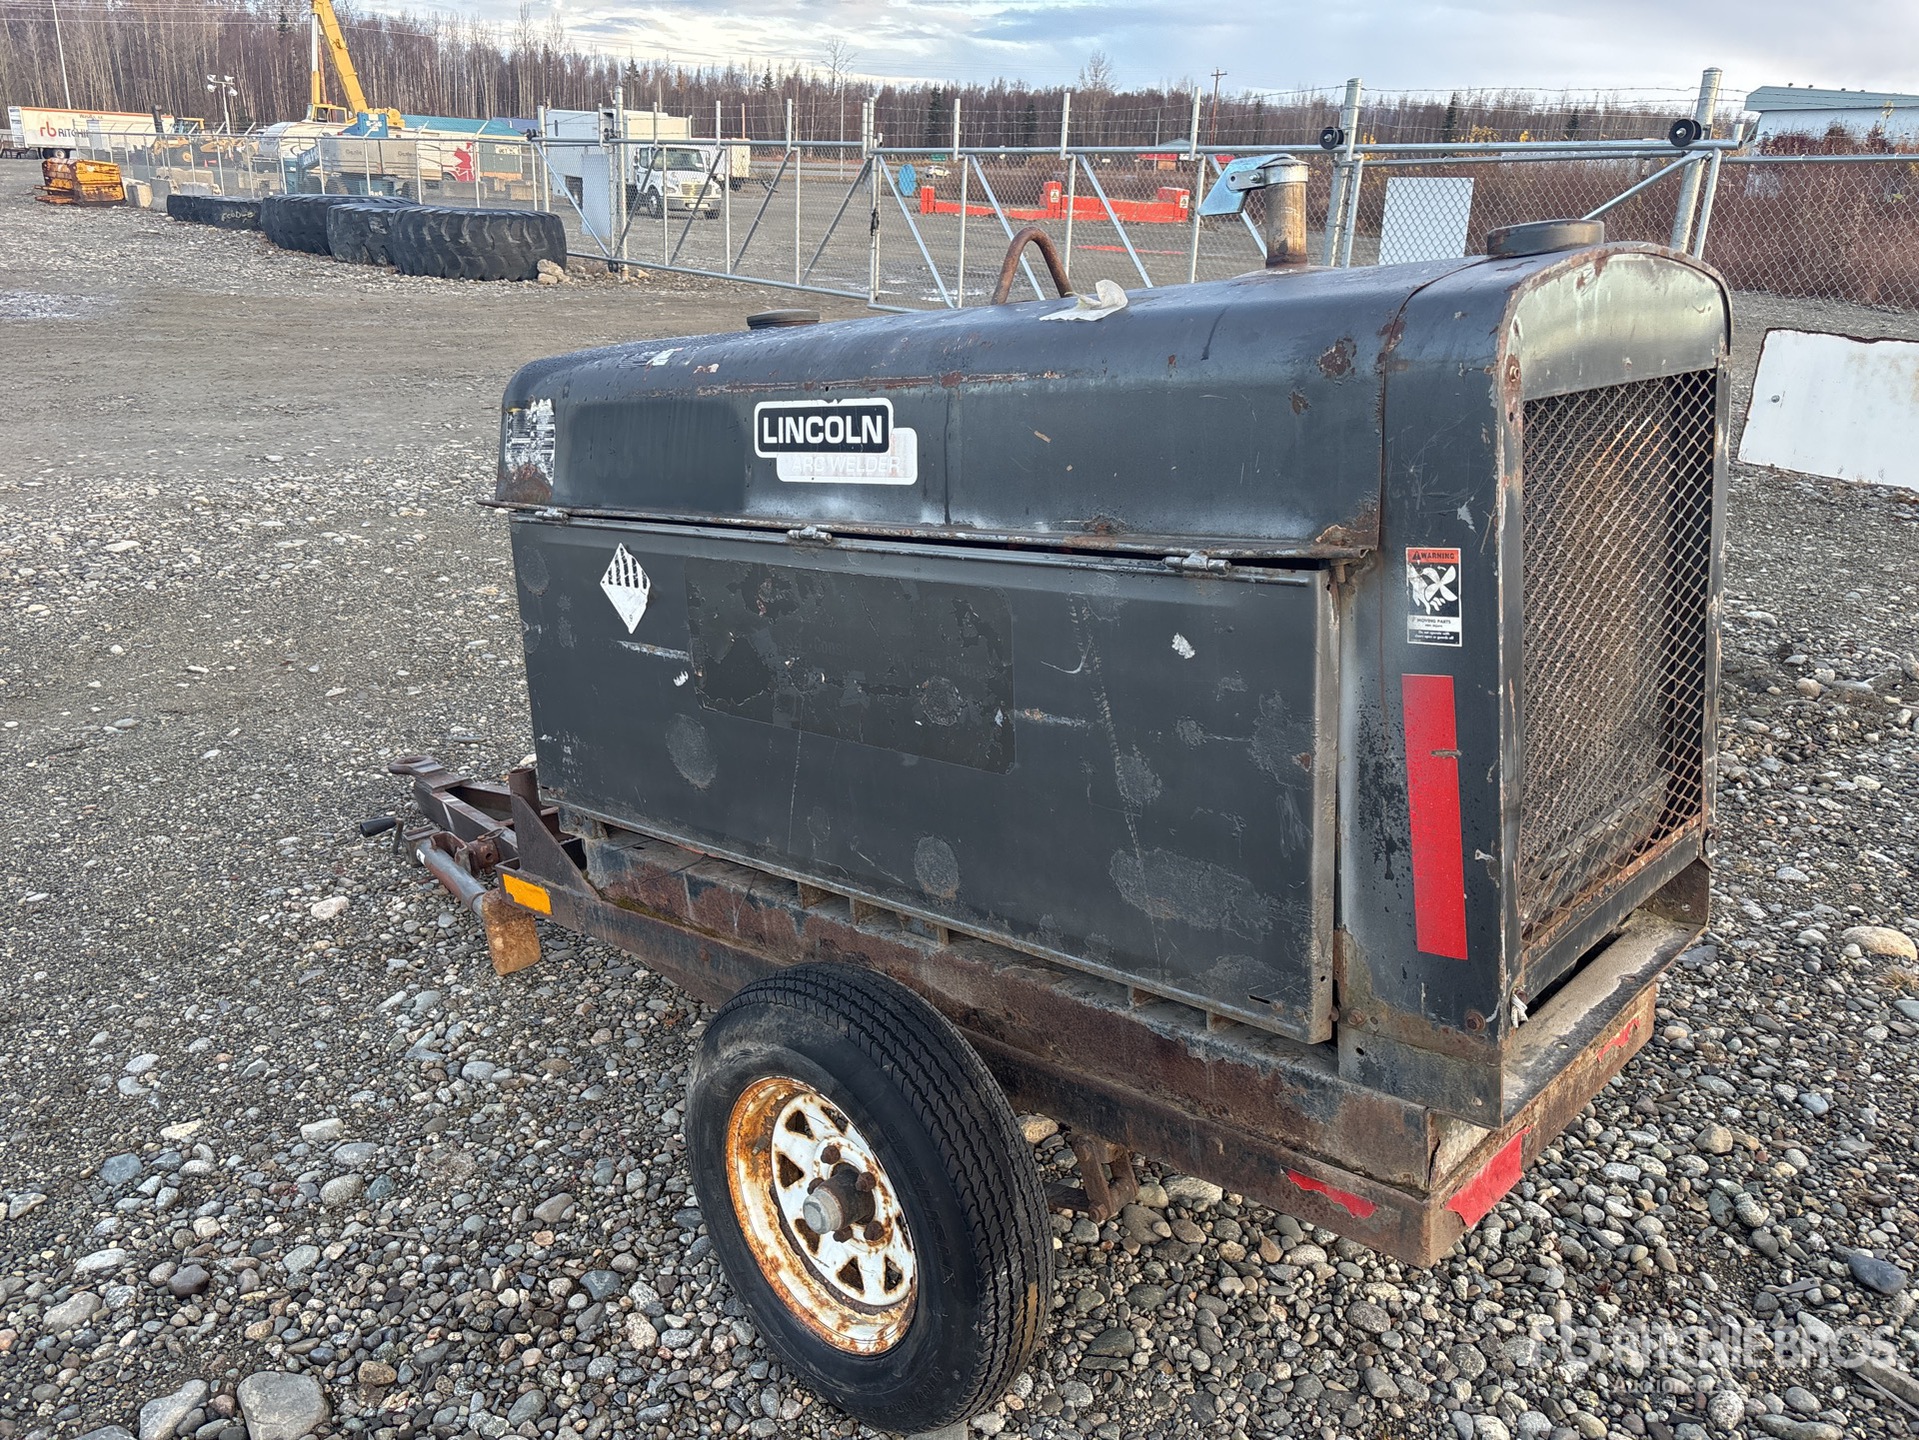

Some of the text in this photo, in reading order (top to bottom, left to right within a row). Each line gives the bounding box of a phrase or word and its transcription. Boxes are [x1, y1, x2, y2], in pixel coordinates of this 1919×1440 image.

[763, 415, 883, 444] LINCOLN
[792, 456, 901, 474] ARC WELDER
[1421, 552, 1455, 560] WARNING
